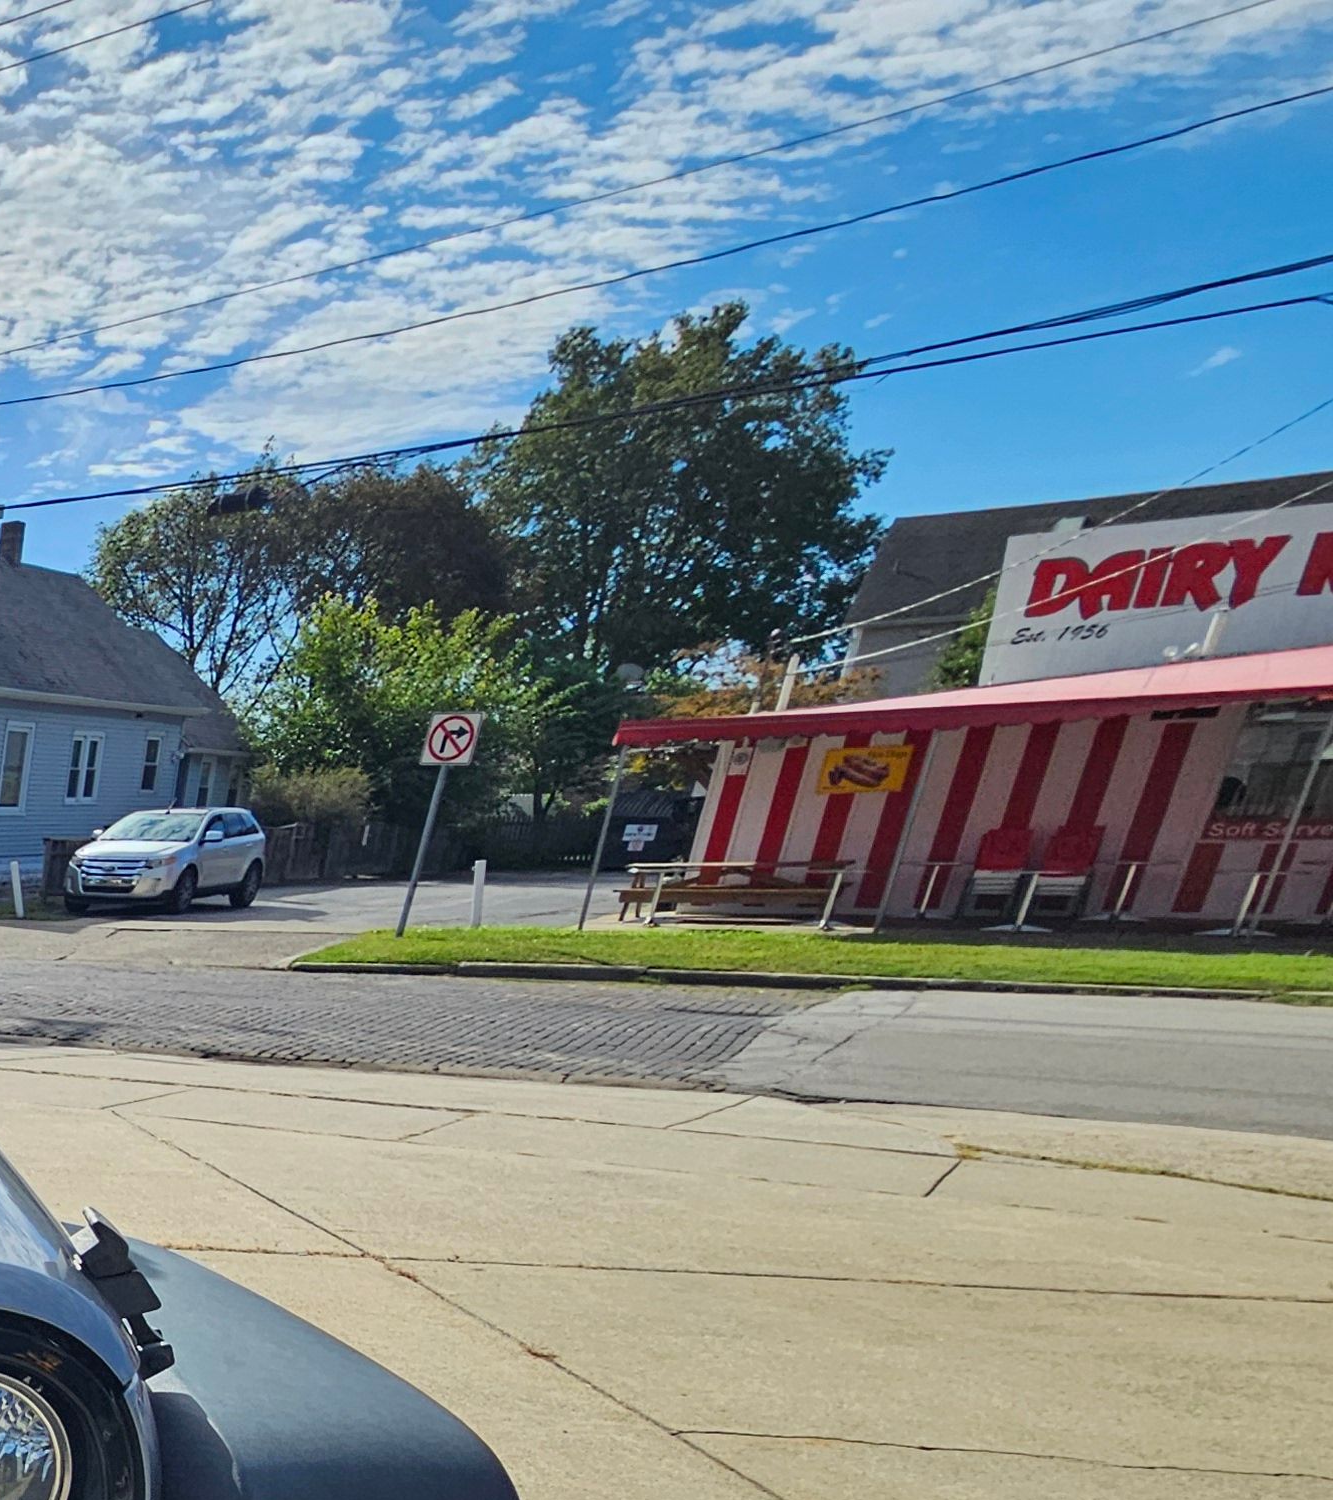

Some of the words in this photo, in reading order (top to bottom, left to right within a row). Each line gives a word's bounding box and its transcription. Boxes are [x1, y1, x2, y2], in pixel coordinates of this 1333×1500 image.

[1023, 534, 1292, 620] DAIRY
[1058, 622, 1110, 641] 1956
[1208, 821, 1257, 837] Soft
[1261, 821, 1333, 837] Srve
